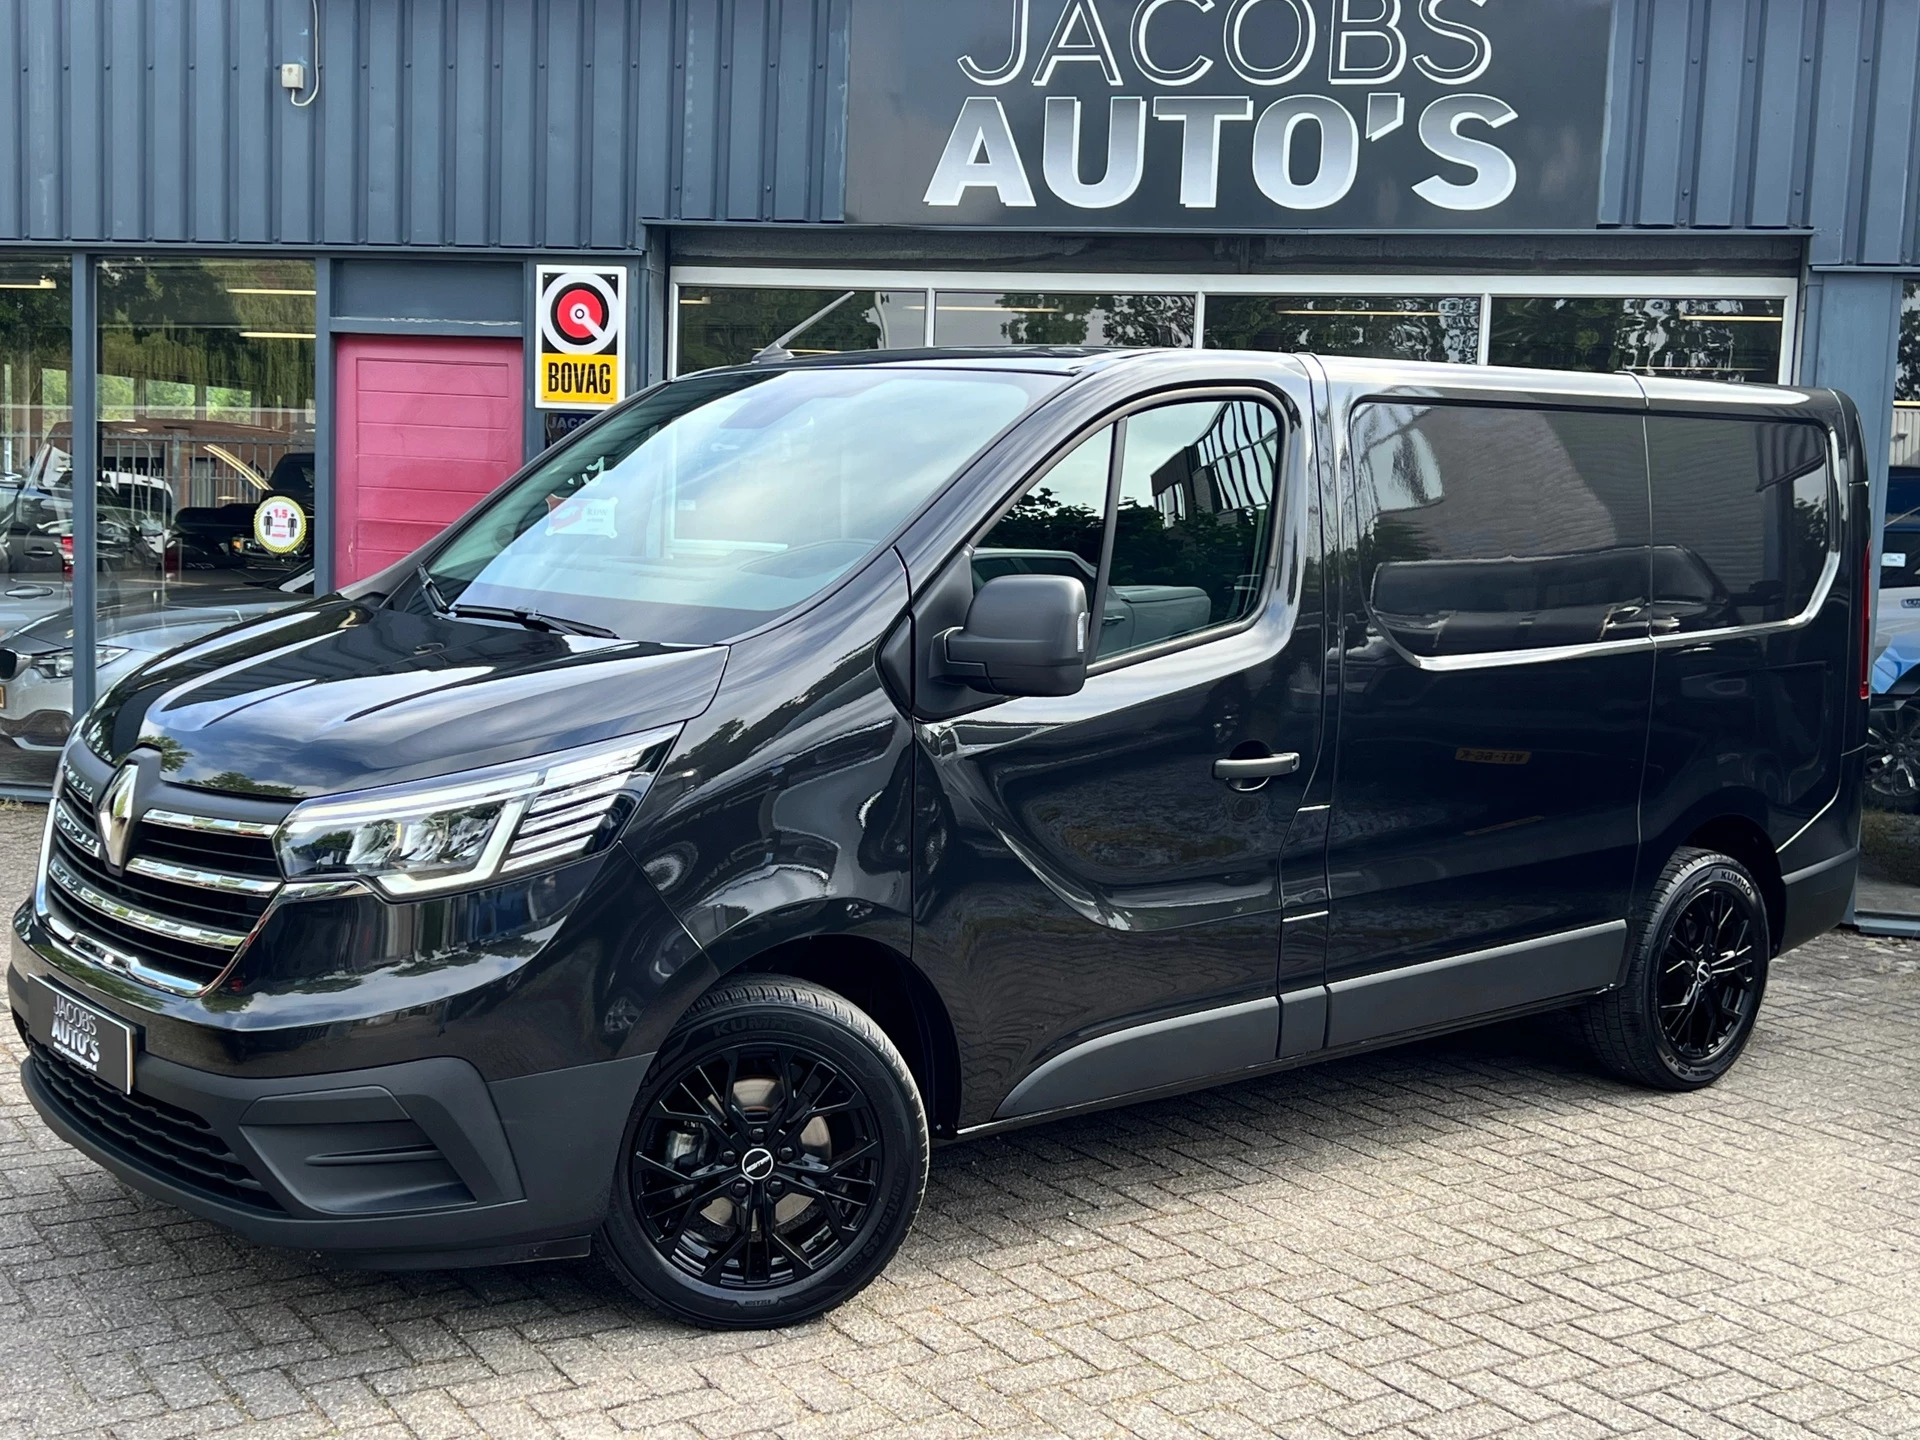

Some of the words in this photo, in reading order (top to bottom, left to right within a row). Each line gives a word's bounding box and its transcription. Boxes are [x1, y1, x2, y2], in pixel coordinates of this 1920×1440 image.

[957, 0, 1504, 86] JACOBS
[922, 93, 1518, 211] AUTO'S
[548, 361, 611, 395] BOVAG
[1720, 870, 1752, 897] KUMHO
[53, 994, 97, 1036] JACOBS
[711, 1015, 806, 1037] KUMHO
[51, 1014, 100, 1062] AUTO'S
